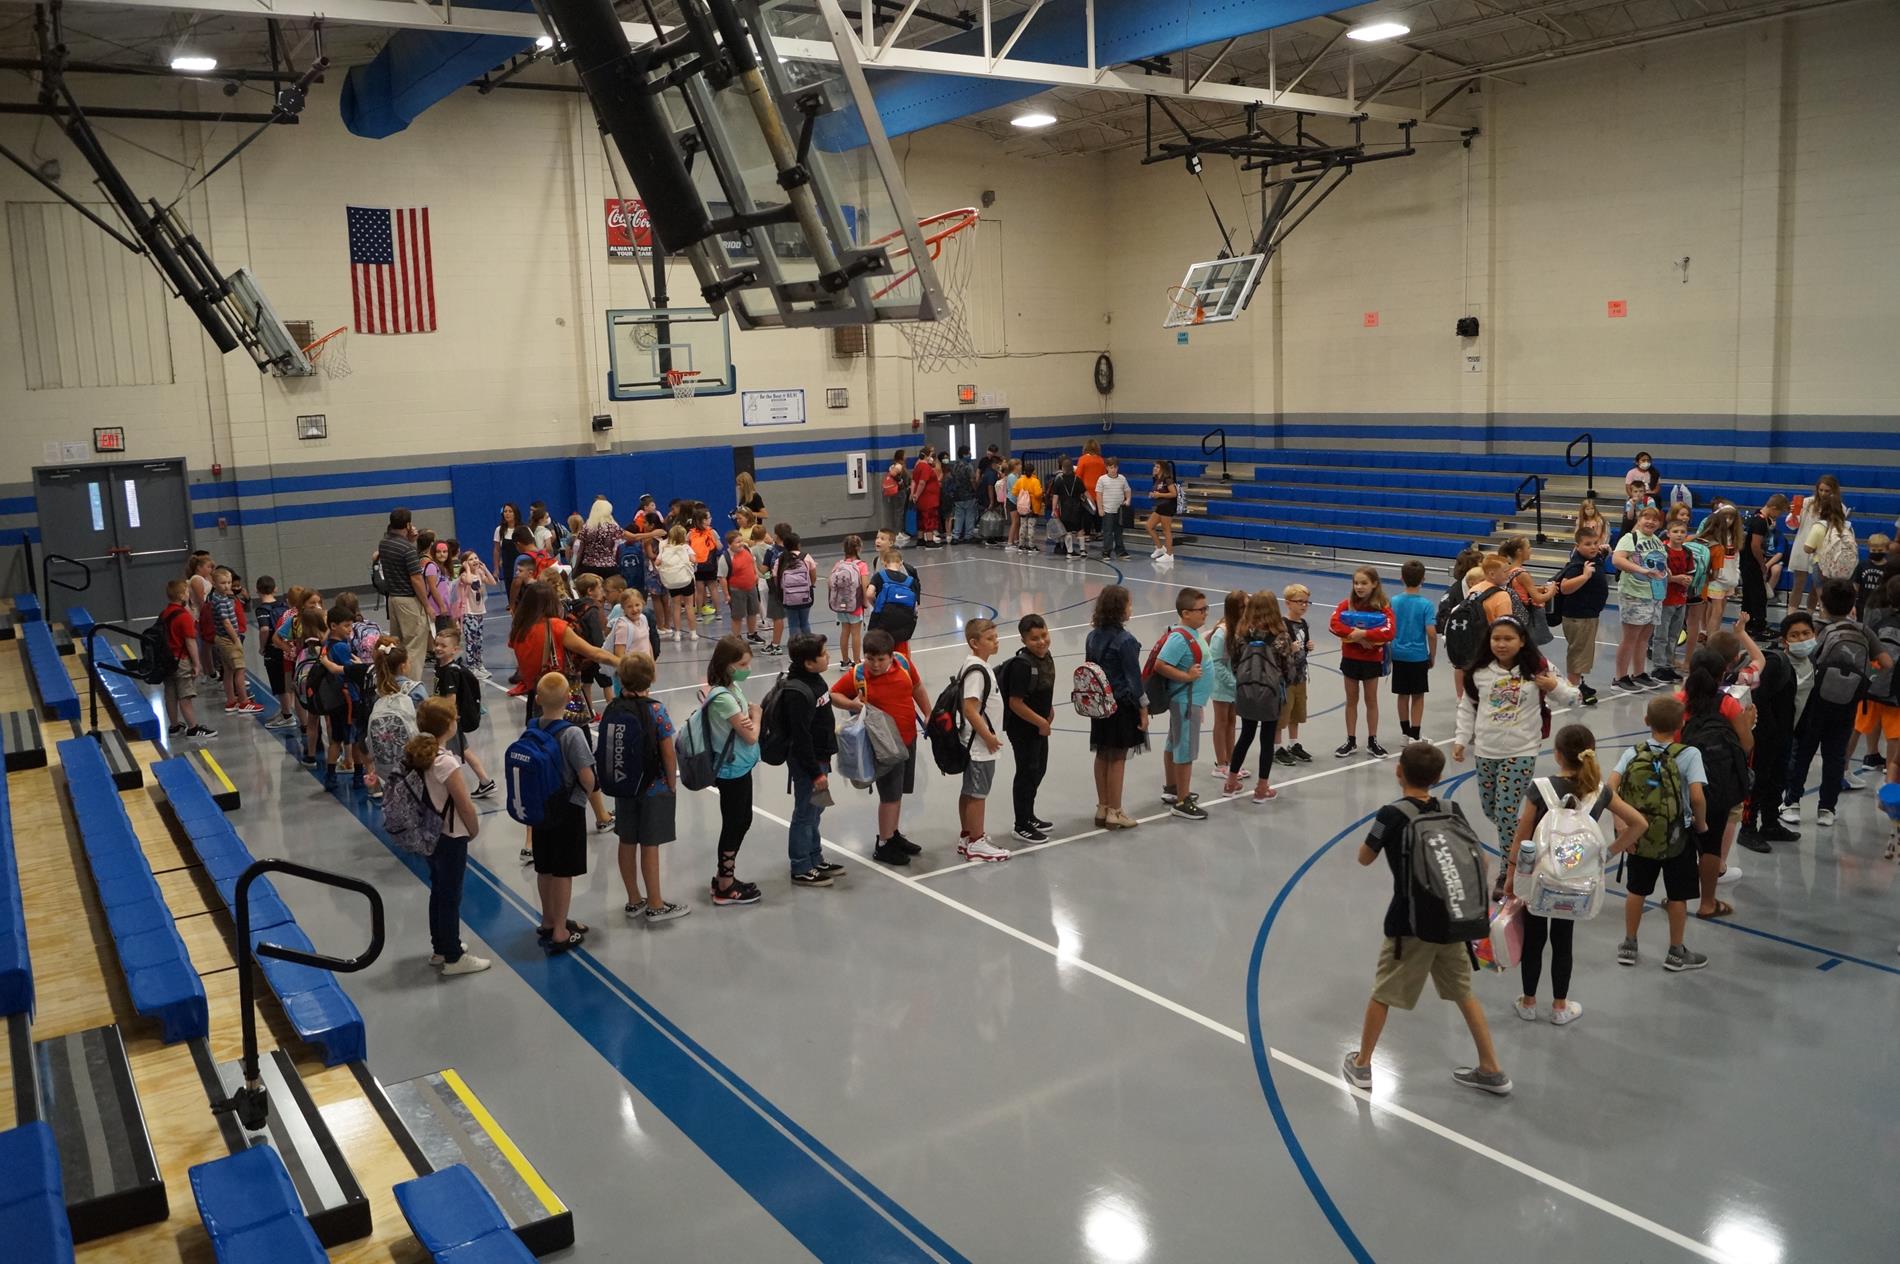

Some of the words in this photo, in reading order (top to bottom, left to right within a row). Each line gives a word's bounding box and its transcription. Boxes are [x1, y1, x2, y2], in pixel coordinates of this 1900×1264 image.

[101, 432, 120, 448] EXIT
[615, 724, 625, 768] Reebok
[1434, 849, 1464, 919] ARMOUR
[1440, 846, 1465, 901] UNDER
